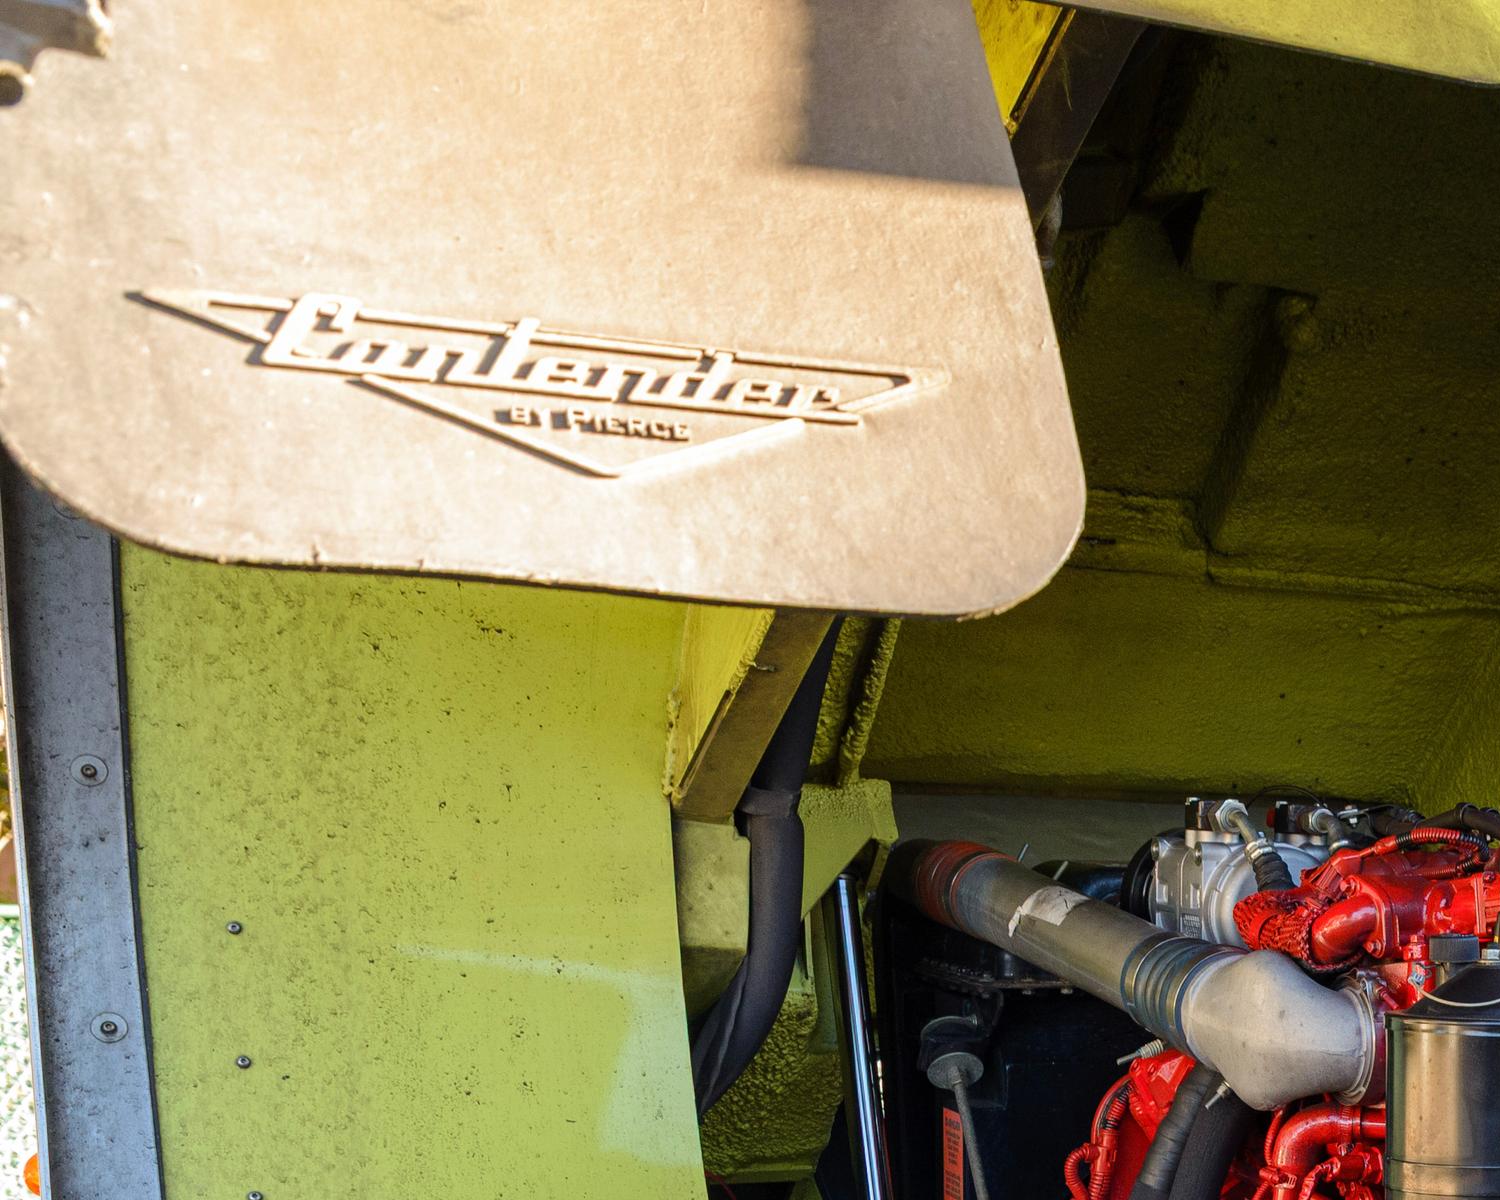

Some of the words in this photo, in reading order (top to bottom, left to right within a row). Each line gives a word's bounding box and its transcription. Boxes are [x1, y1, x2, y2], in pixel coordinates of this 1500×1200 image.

[262, 292, 855, 425] Contender
[510, 404, 553, 431] BY
[567, 407, 690, 441] PIERCE
